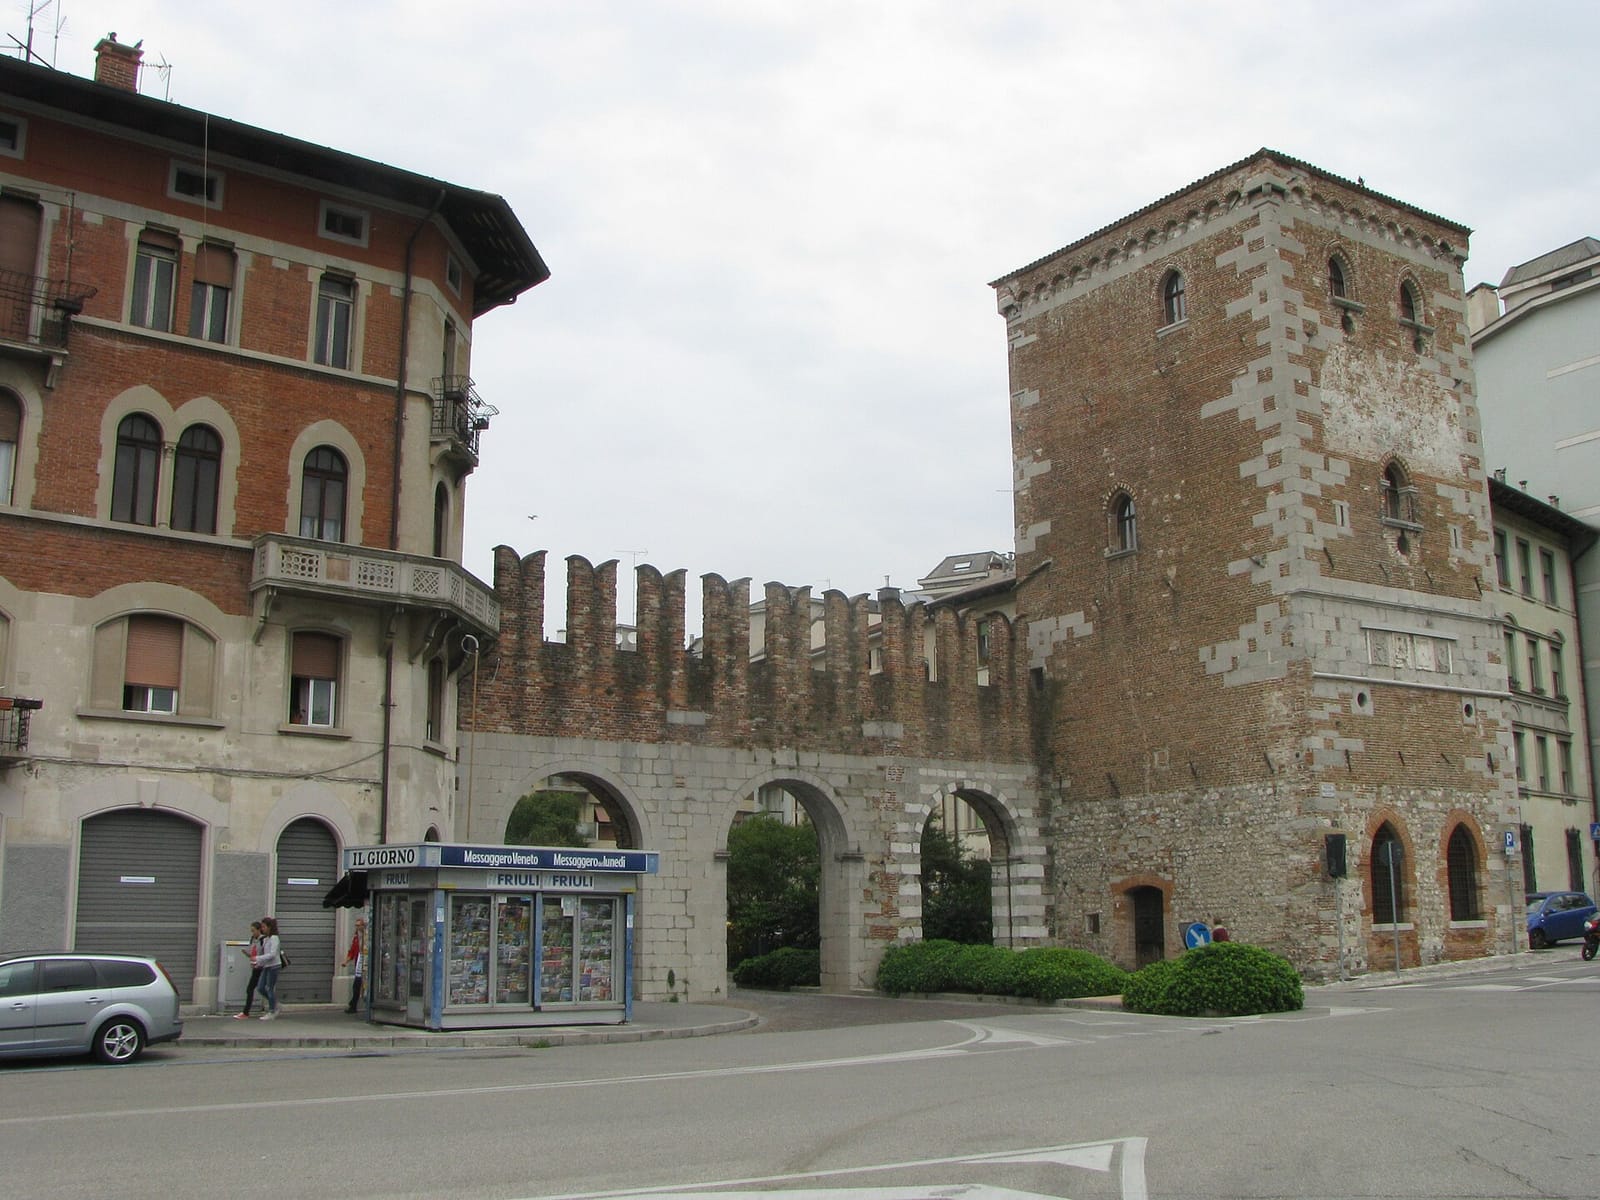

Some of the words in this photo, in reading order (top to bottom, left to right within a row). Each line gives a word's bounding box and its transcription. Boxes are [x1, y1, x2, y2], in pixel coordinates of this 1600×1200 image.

[1506, 832, 1513, 846] P
[353, 852, 366, 866] IL
[367, 848, 415, 865] GIORNO
[497, 873, 540, 887] FRIULI
[552, 875, 593, 888] FRIULI
